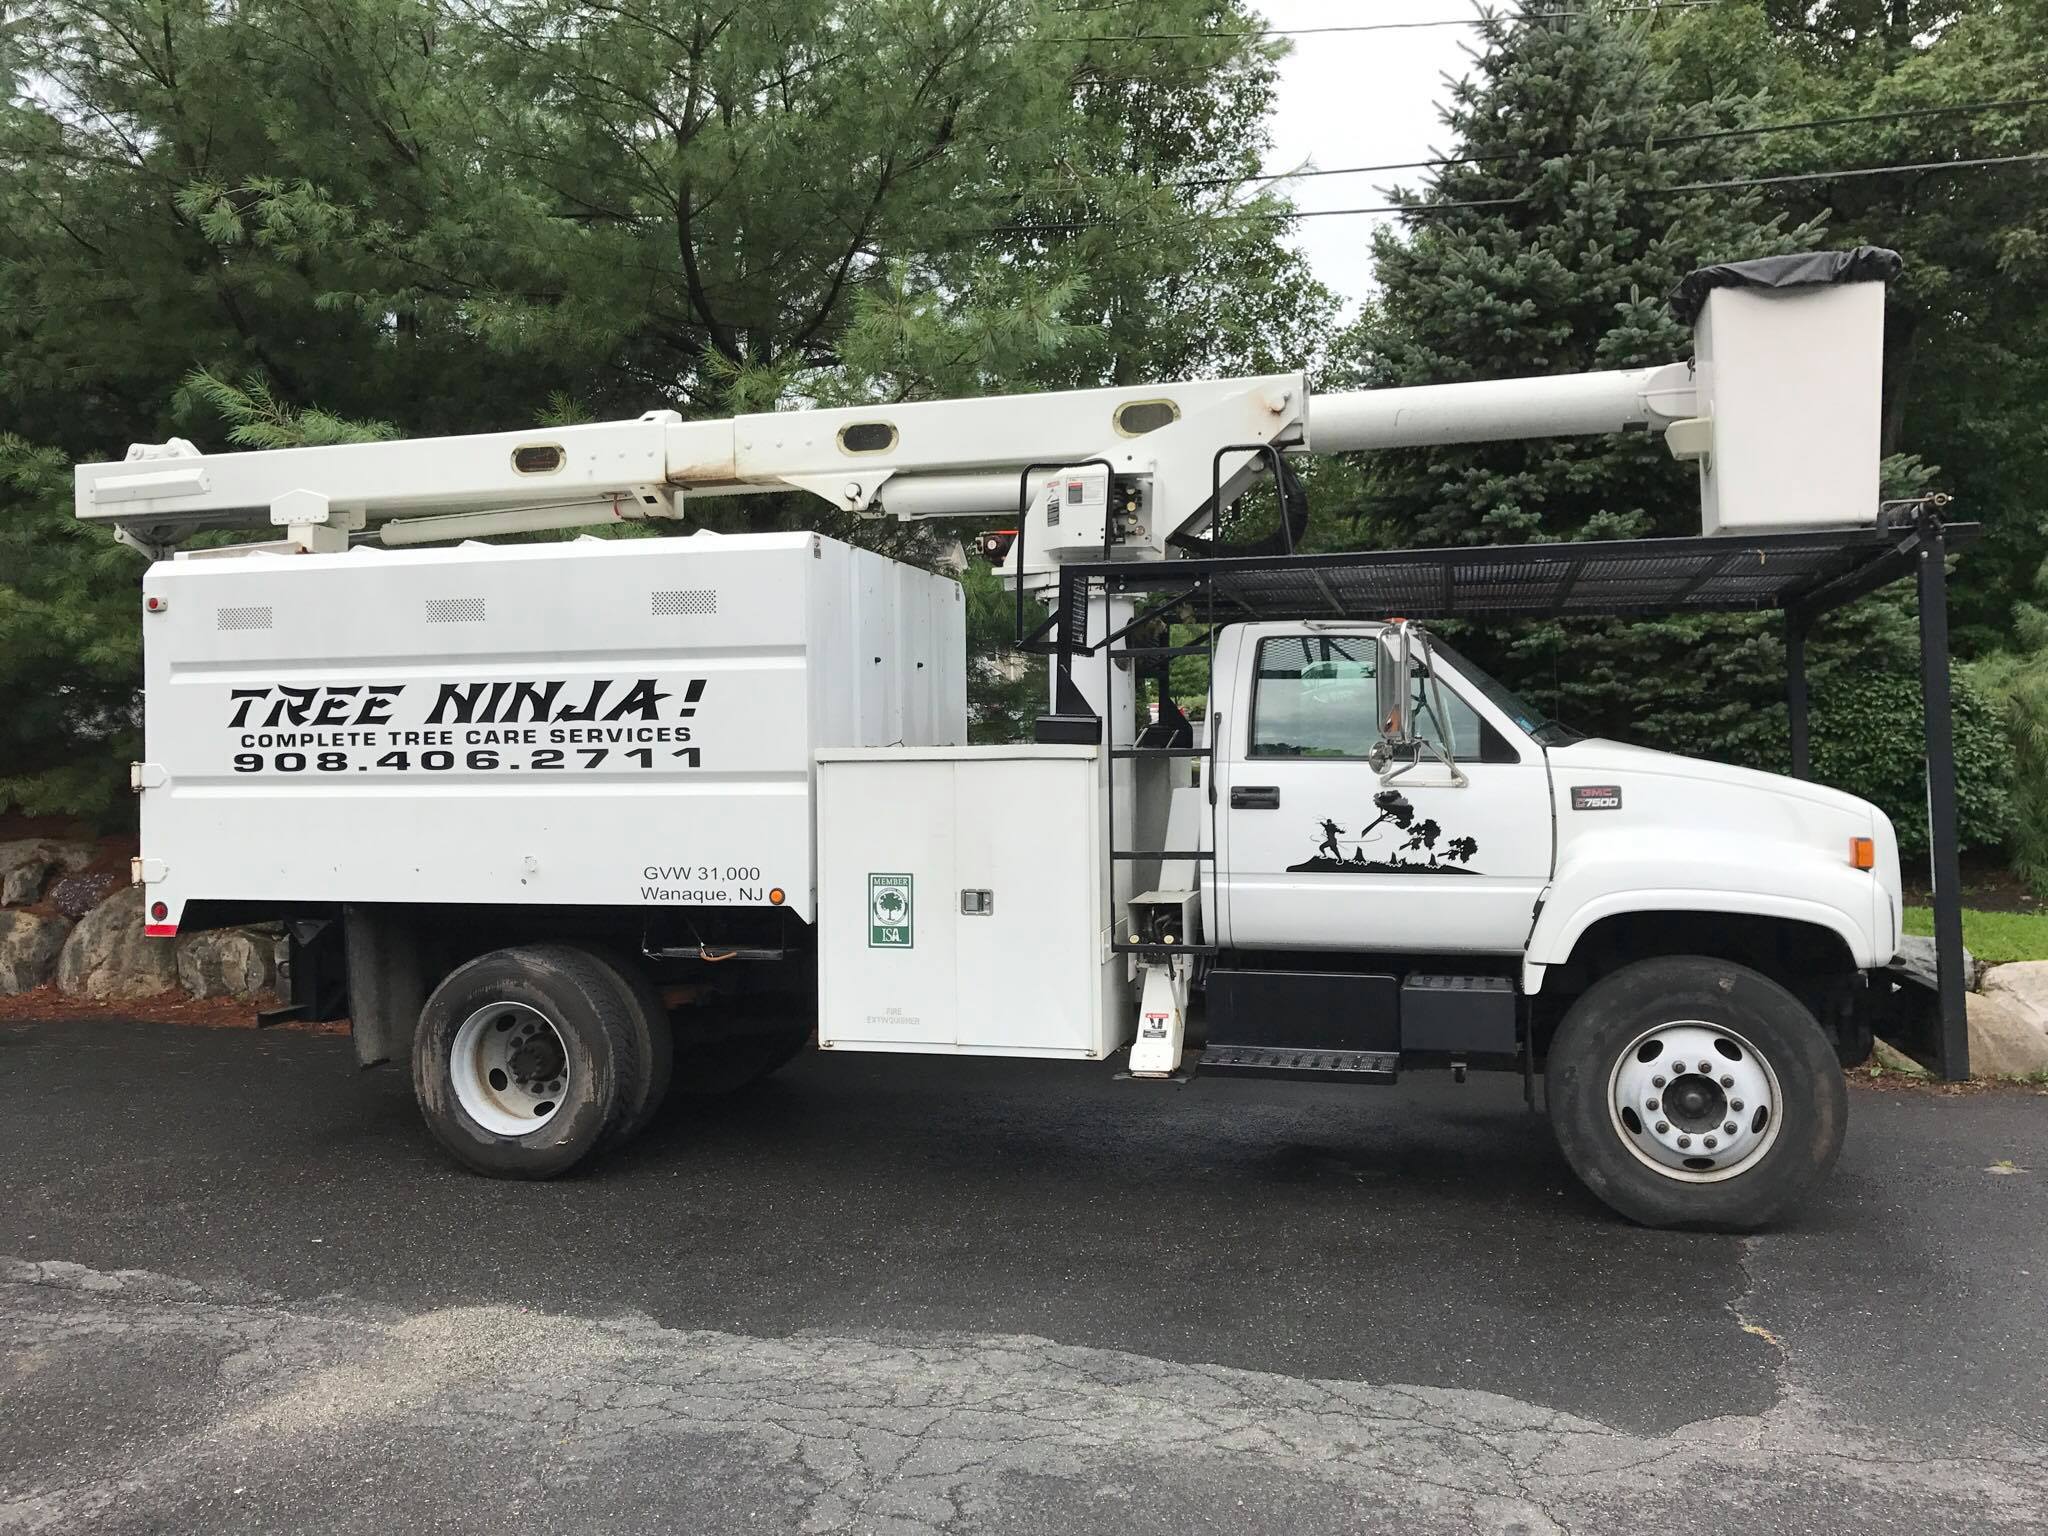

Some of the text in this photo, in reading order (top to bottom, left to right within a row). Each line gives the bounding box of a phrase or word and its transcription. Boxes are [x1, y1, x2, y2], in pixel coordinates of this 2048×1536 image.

[228, 679, 708, 728] TREE NINJA!
[241, 727, 691, 748] COMPLETE TREE CARE SERVICES
[233, 746, 701, 773] 908.406.2711
[1581, 788, 1613, 797] GMC
[643, 866, 760, 882] GVW 31,000
[873, 877, 909, 886] MEMBER
[641, 886, 763, 903] Wanaque, NJ
